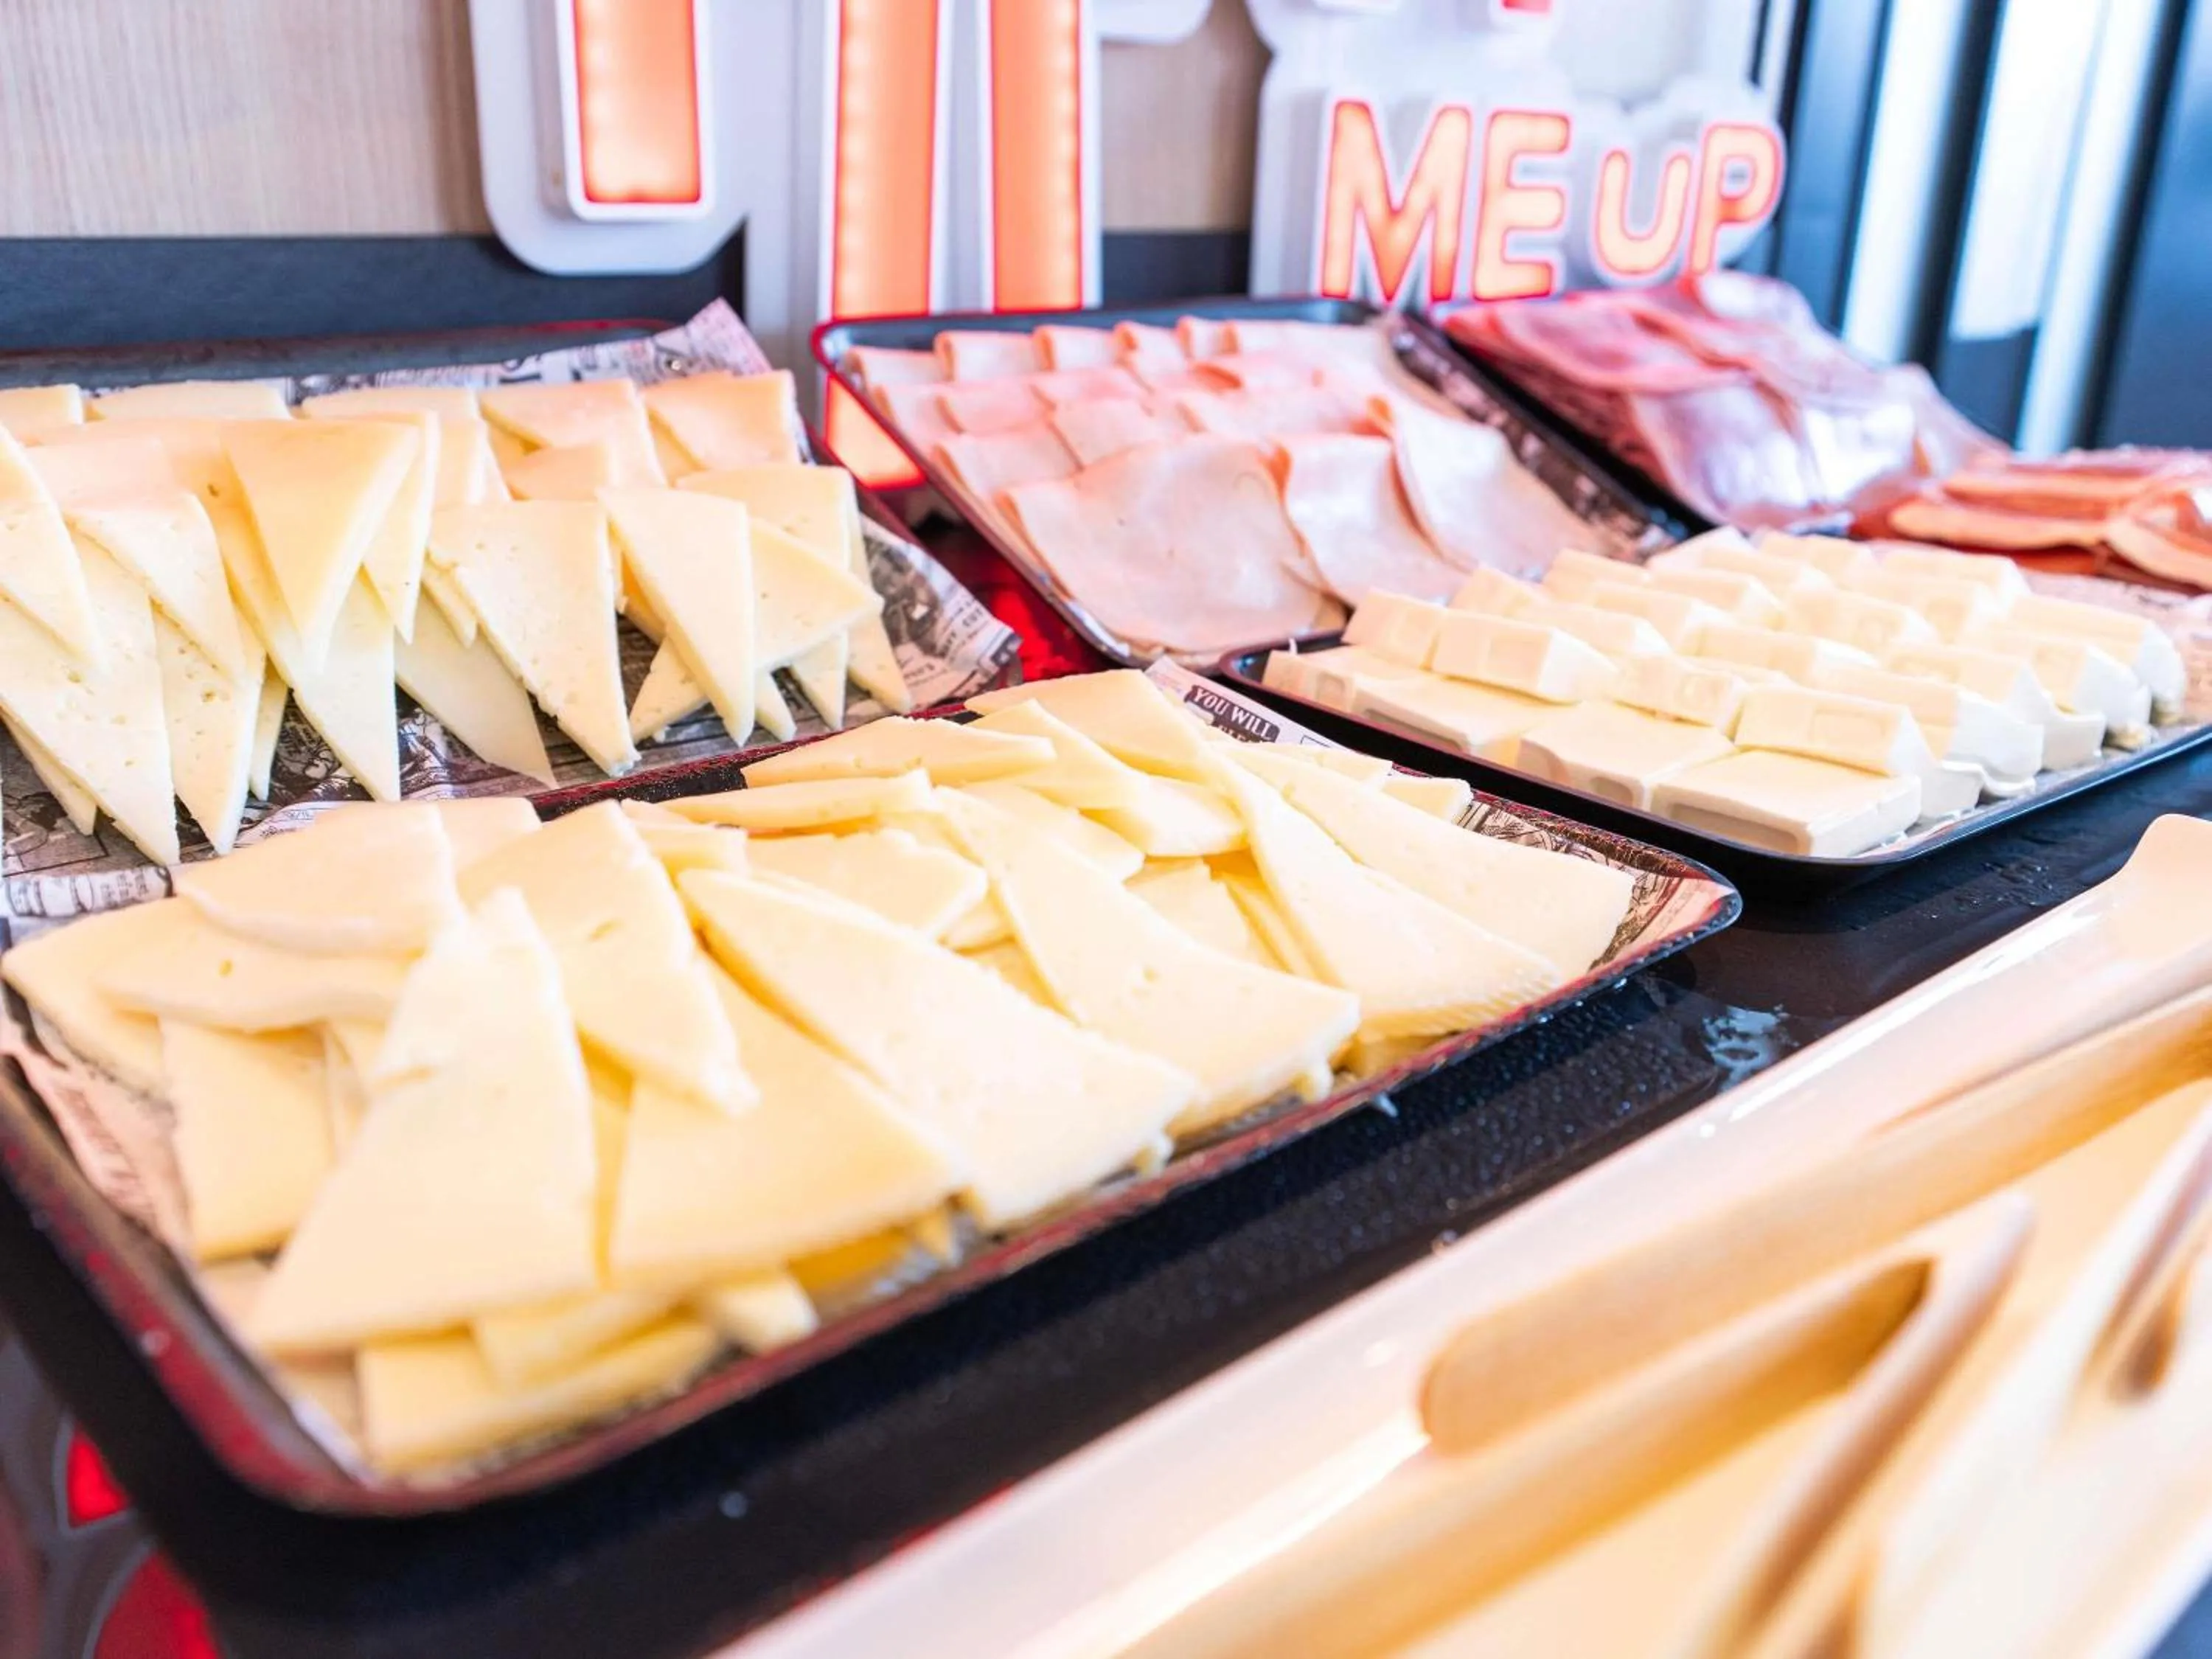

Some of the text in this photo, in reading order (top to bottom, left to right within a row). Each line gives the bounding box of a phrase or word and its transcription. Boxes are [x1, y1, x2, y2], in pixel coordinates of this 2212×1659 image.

[1320, 98, 1784, 302] ME UP
[1193, 686, 1231, 715] YOU
[1231, 706, 1273, 740] WILL
